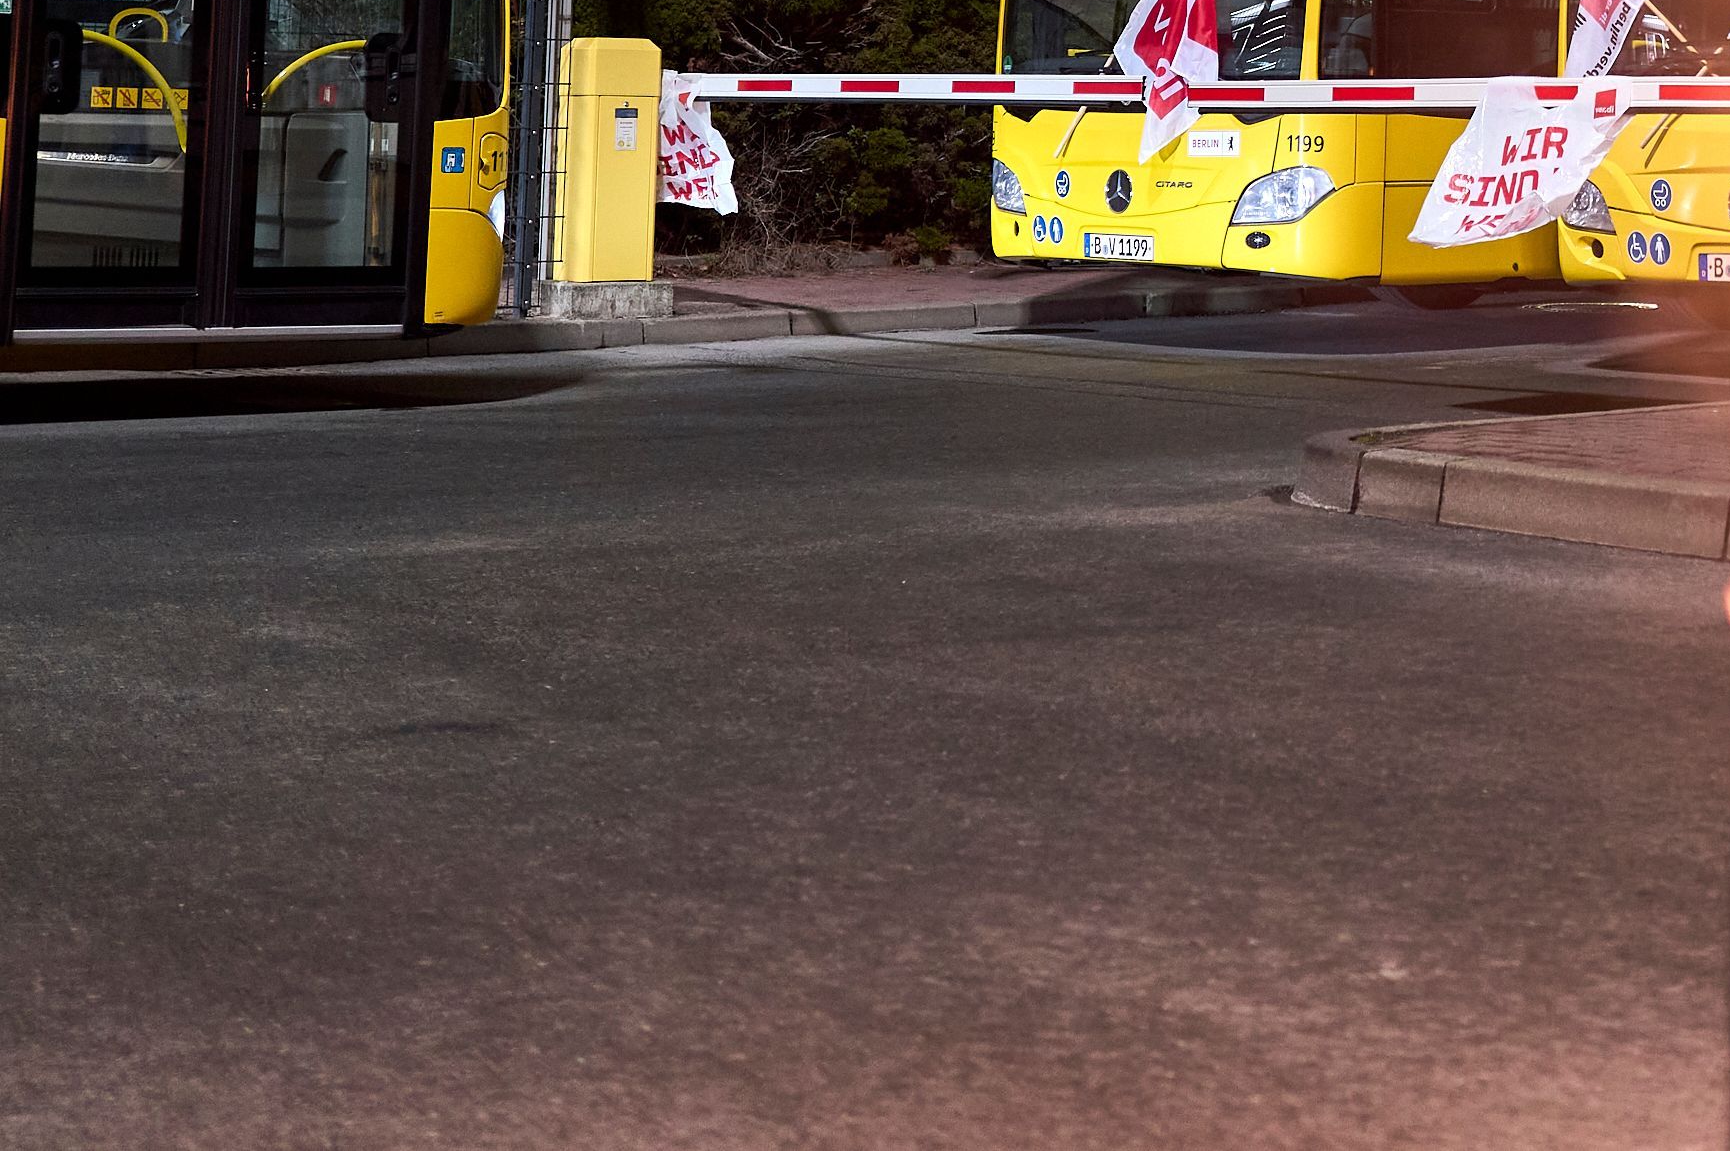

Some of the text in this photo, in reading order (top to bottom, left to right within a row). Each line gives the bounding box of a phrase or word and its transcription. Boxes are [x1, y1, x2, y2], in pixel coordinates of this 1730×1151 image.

[1192, 138, 1220, 149] BERLIN
[1286, 134, 1325, 153] 1199
[1500, 126, 1568, 167] WIR
[656, 143, 721, 177] IND
[1155, 180, 1193, 189] CITARO
[1443, 169, 1539, 207] SIND
[1094, 236, 1102, 254] B
[1714, 257, 1724, 278] B
